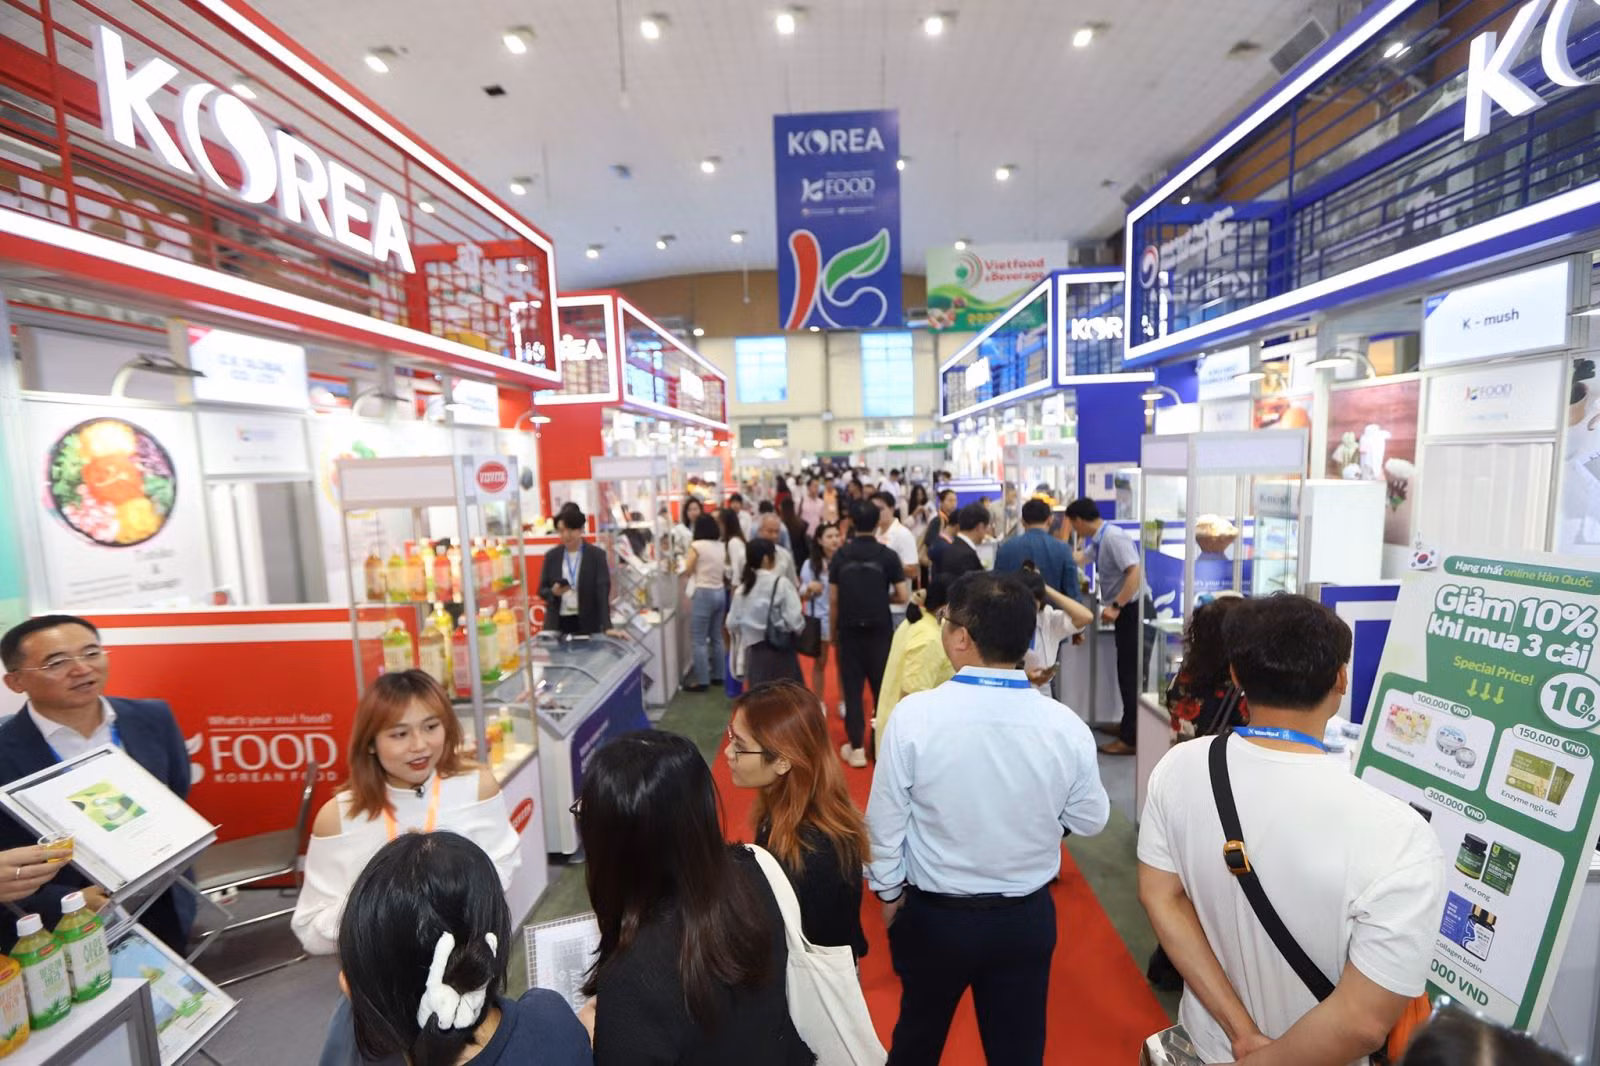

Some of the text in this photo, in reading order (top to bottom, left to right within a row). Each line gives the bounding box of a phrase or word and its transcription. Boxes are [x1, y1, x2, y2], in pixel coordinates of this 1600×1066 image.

[94, 25, 416, 274] KOREA
[787, 127, 885, 155] KOREA
[826, 177, 876, 195] FOOD
[985, 257, 1045, 270] Vietfood
[1462, 318, 1471, 331] K
[1483, 308, 1520, 327] mush
[1504, 568, 1537, 580] online
[1435, 584, 1598, 639] Giảm 10%
[1427, 613, 1591, 670] khi mua 3 cái
[1453, 655, 1535, 686] Special Price!
[1452, 705, 1469, 717] VND
[208, 732, 338, 771] FOOD
[1565, 742, 1586, 755] VND
[213, 772, 285, 783] KOREAN
[1501, 789, 1529, 806] Enzyme
[1466, 808, 1484, 820] VND
[1477, 890, 1491, 903] ong
[1436, 939, 1483, 974] Collagen biotin
[1459, 976, 1489, 1006] VND
